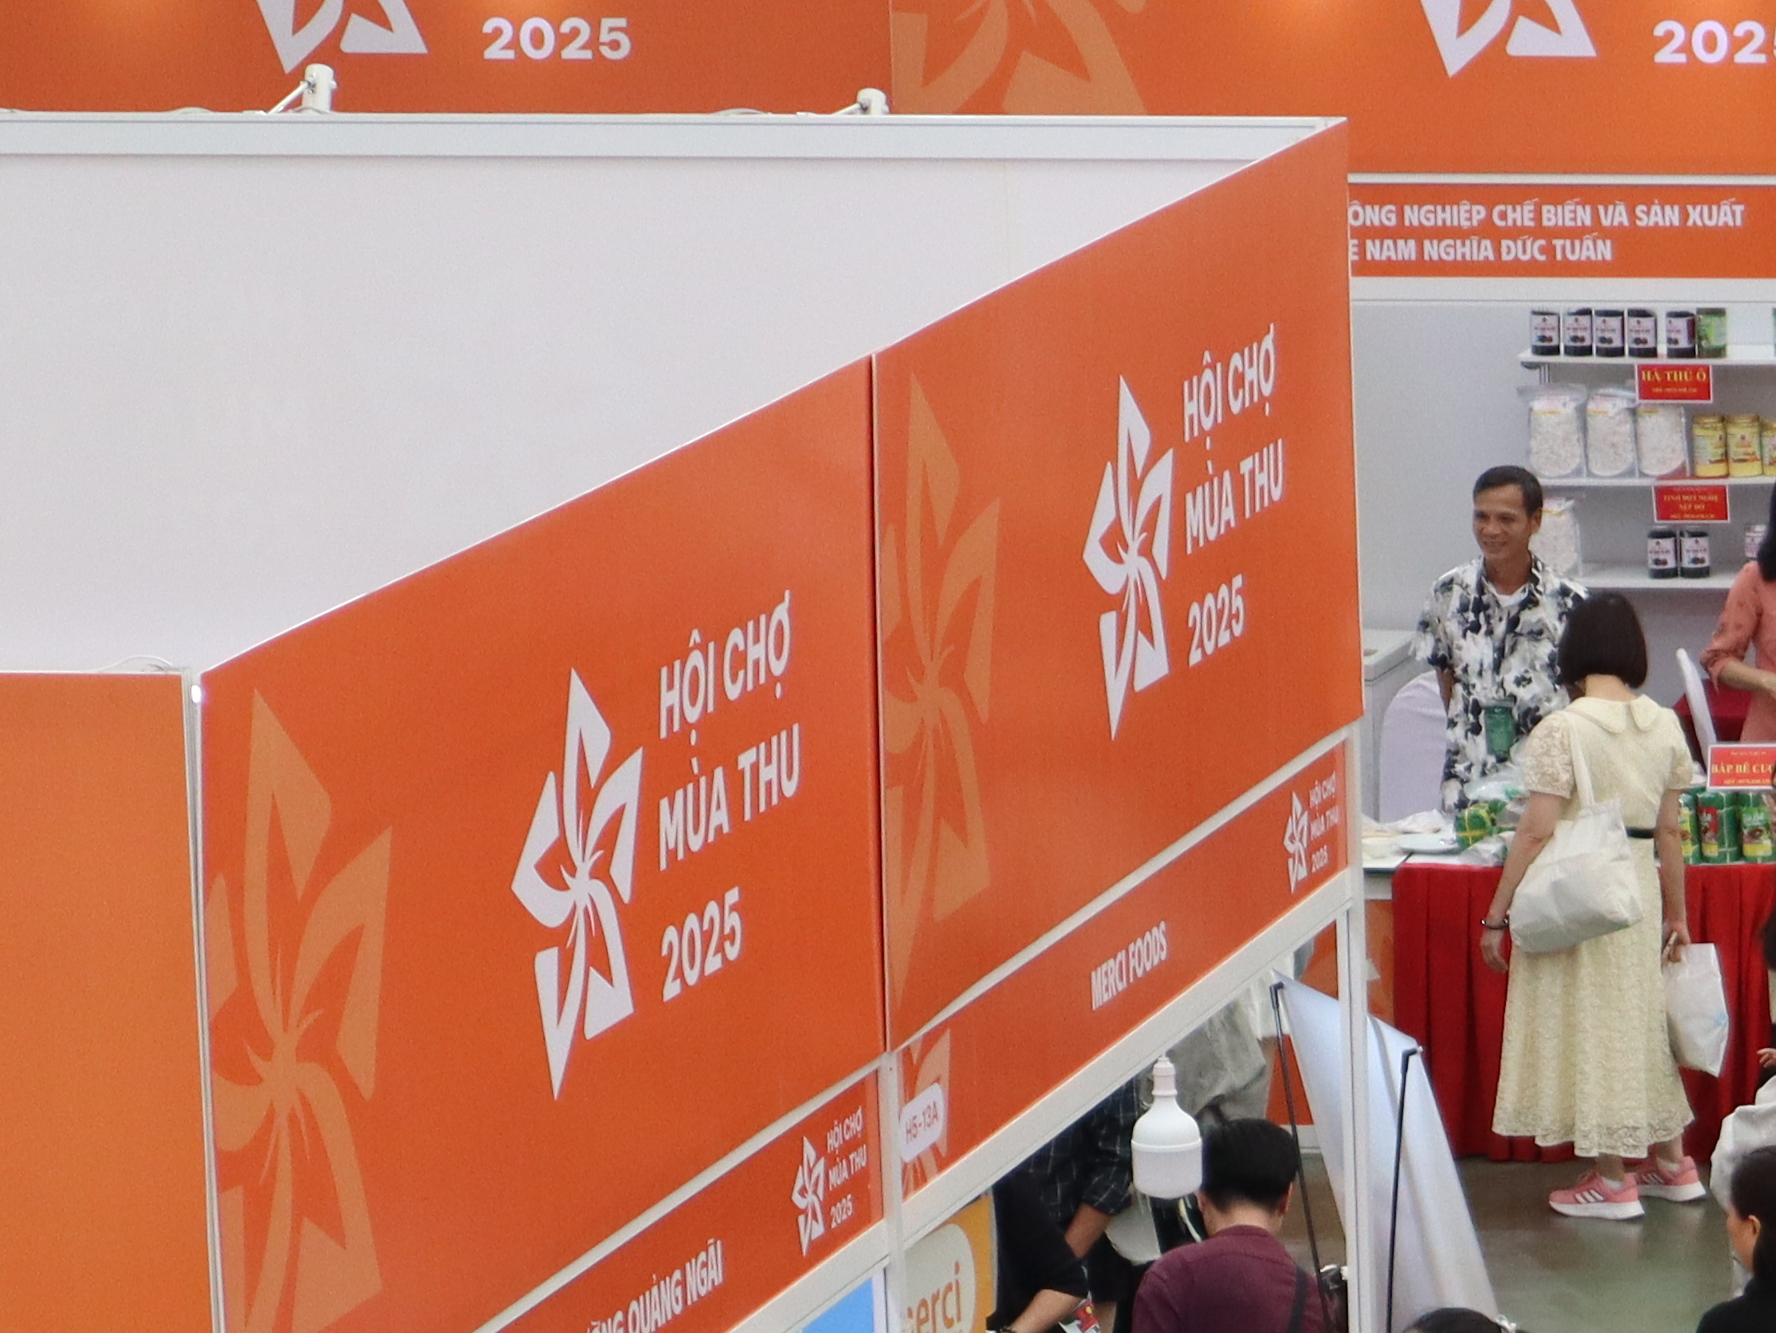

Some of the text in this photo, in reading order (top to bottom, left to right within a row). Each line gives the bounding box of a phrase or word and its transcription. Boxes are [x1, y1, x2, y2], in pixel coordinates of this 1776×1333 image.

[482, 15, 631, 61] 2025
[1348, 197, 1744, 229] ÔNG NGHIỆP CHẾ BIẾN VÀ SẢN XUẤT
[1366, 239, 1416, 261] NAM
[1424, 234, 1494, 262] NGHĨA
[1501, 235, 1546, 261] ĐỨC
[1552, 231, 1612, 261] TUẤN
[1183, 322, 1276, 450] HỘI CHỢ
[1185, 438, 1284, 555] MÙA THU
[1188, 574, 1245, 667] 2025
[659, 589, 791, 747] HỘI CHỢ
[659, 722, 800, 872] MÙA THU
[1311, 845, 1329, 873] 2025
[660, 886, 742, 1002] 2025
[1091, 920, 1169, 1011] MERCI FOODS
[827, 1105, 864, 1155] HỘI CHỢ
[905, 1100, 939, 1145] H5-13A
[828, 1144, 868, 1191] MÙA THU
[830, 1194, 854, 1229] 2025
[685, 1238, 724, 1306] NGÃI
